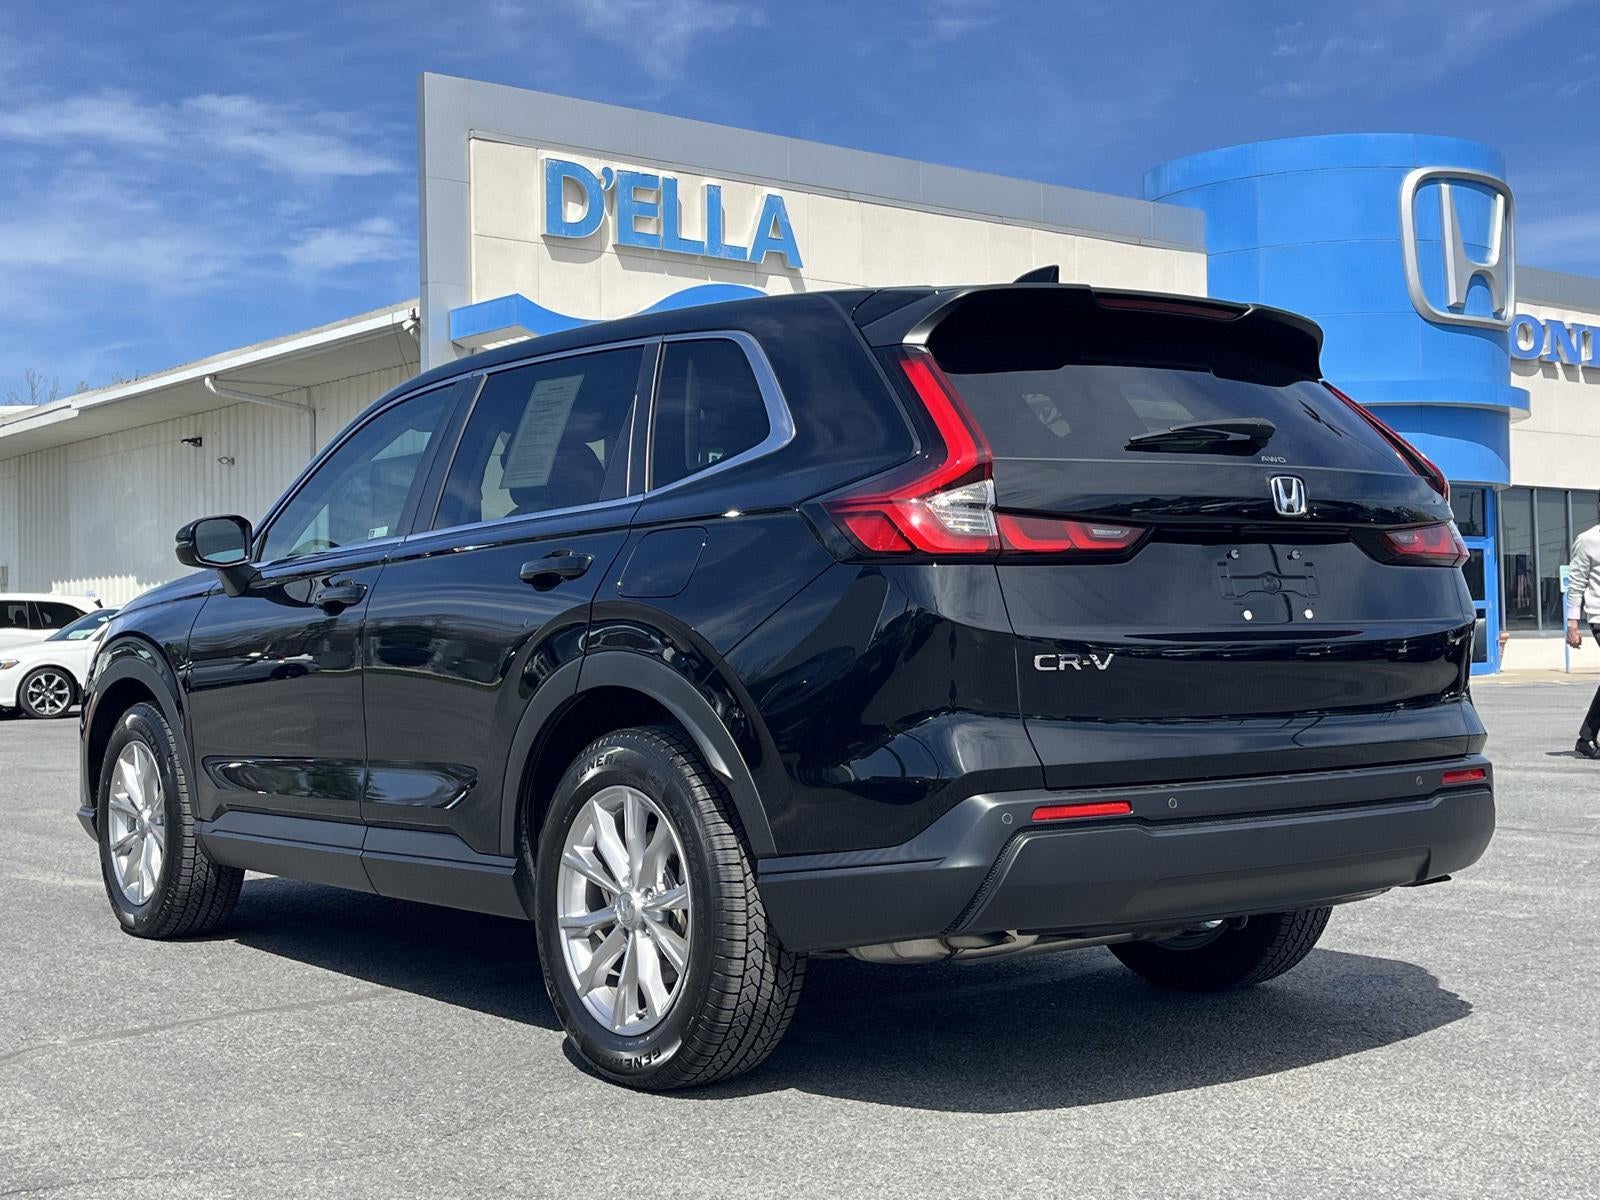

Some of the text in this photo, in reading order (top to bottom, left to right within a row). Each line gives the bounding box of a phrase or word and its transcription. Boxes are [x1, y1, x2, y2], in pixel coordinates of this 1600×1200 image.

[542, 157, 803, 268] D'ELLA
[1261, 455, 1287, 463] AWD
[1033, 653, 1114, 671] CR-V
